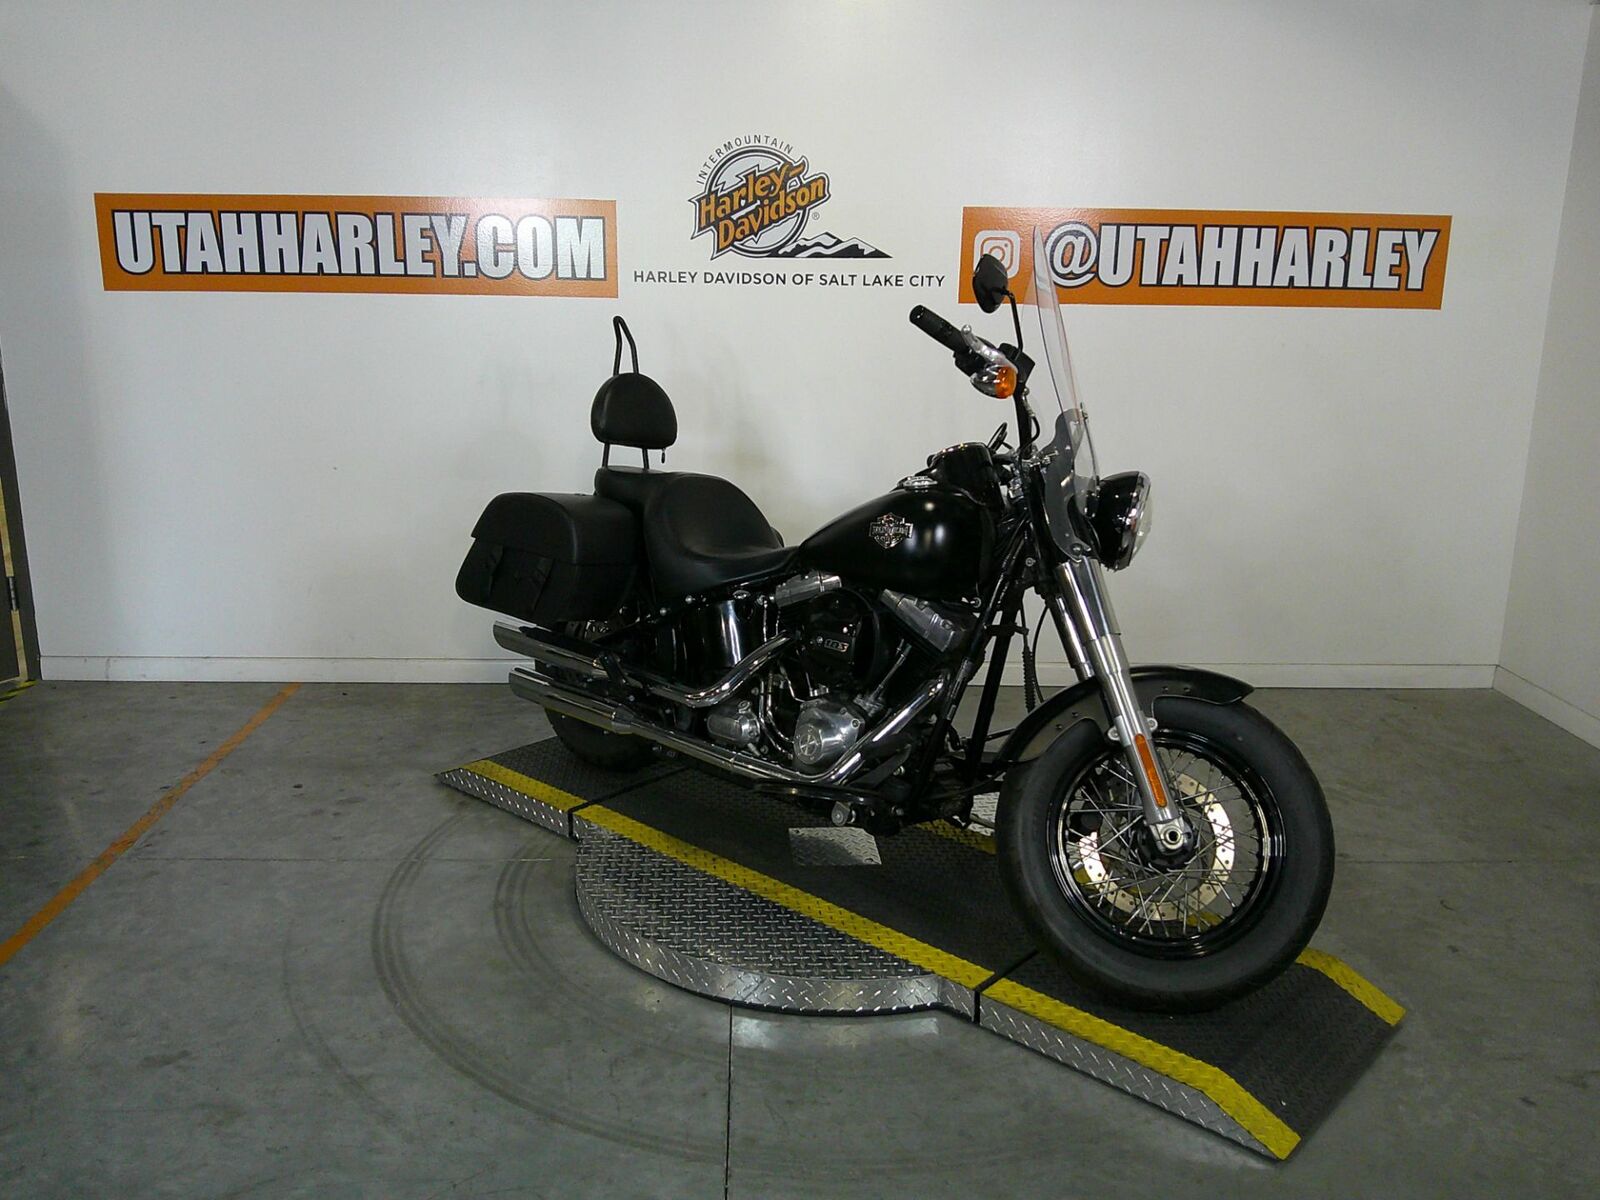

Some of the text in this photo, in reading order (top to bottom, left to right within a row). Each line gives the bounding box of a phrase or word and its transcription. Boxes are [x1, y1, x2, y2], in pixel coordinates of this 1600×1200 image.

[696, 134, 794, 185] INTERMOUNTAIN
[111, 208, 608, 282] UTAHHARLEY.COM
[717, 175, 827, 250] Davidson
[633, 270, 946, 288] HARLEY DAVIDSON OF SALT LAKE CITY
[1044, 220, 1443, 292] @UTAHHARLEY
